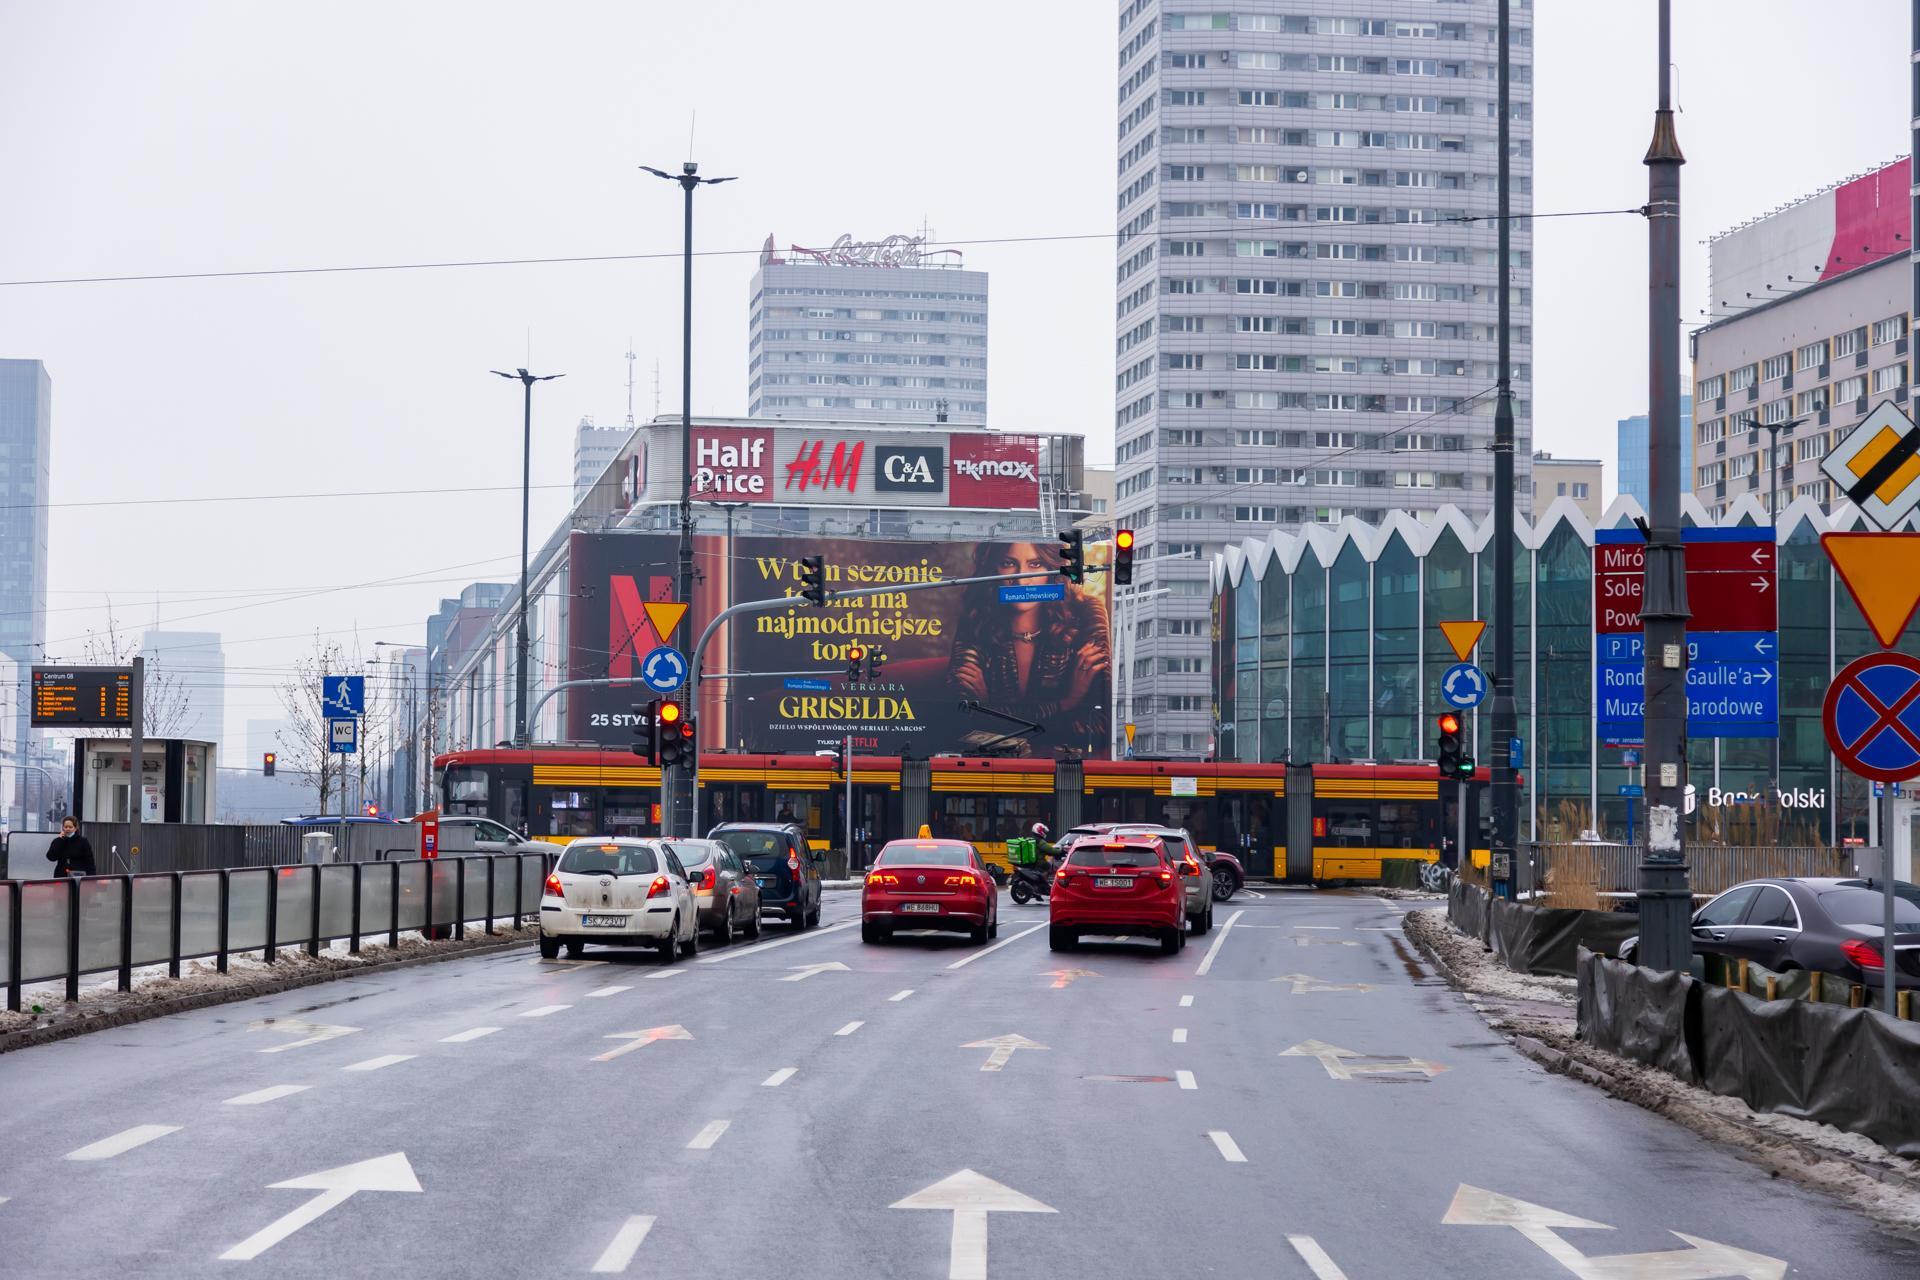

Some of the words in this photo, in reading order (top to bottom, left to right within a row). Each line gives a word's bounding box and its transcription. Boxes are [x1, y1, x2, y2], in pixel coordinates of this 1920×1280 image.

[696, 438, 765, 468] Half
[785, 439, 865, 495] H&M
[884, 455, 935, 483] C&A
[696, 467, 765, 493] Price
[1604, 548, 1646, 568] Miró
[756, 557, 788, 580] W
[847, 559, 943, 583] sezonie
[1604, 578, 1645, 597] Sole
[870, 592, 909, 609] ma
[756, 608, 942, 641] najmodniejsze
[1605, 608, 1641, 627] Pow
[1605, 668, 1645, 686] Rond
[1685, 666, 1752, 685] Gaulle'a
[841, 682, 905, 691] VERGARA
[779, 696, 916, 720] GRISELDA
[1606, 698, 1645, 716] Muze
[1686, 696, 1763, 716] arodowe
[590, 713, 609, 727] 25
[335, 726, 352, 735] WC
[335, 743, 344, 751] 24
[1776, 787, 1825, 809] olski
